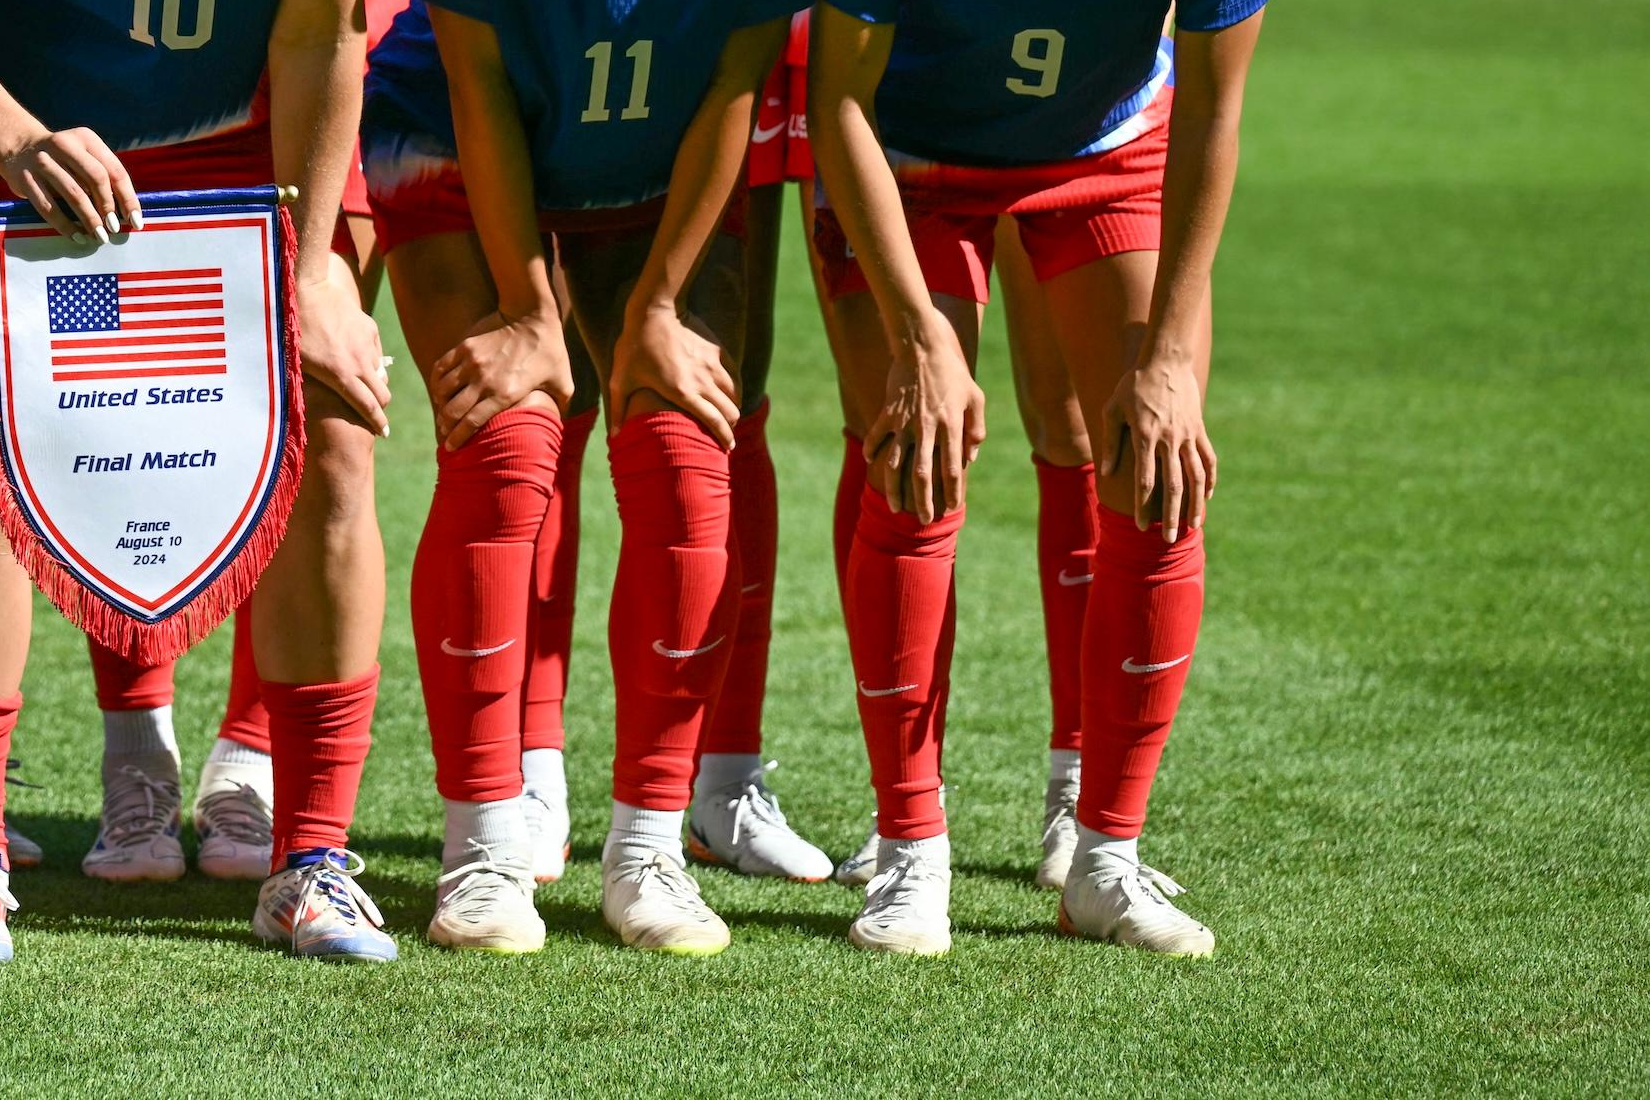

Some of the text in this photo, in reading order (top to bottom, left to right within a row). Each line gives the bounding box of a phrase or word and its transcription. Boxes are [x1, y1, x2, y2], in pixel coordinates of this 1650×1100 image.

[1005, 28, 1066, 99] 9
[580, 39, 654, 123] 11
[58, 386, 224, 409] United States
[73, 450, 217, 473] Final Match
[126, 520, 170, 533] France
[115, 535, 182, 550] August 10
[133, 554, 166, 565] 2024
